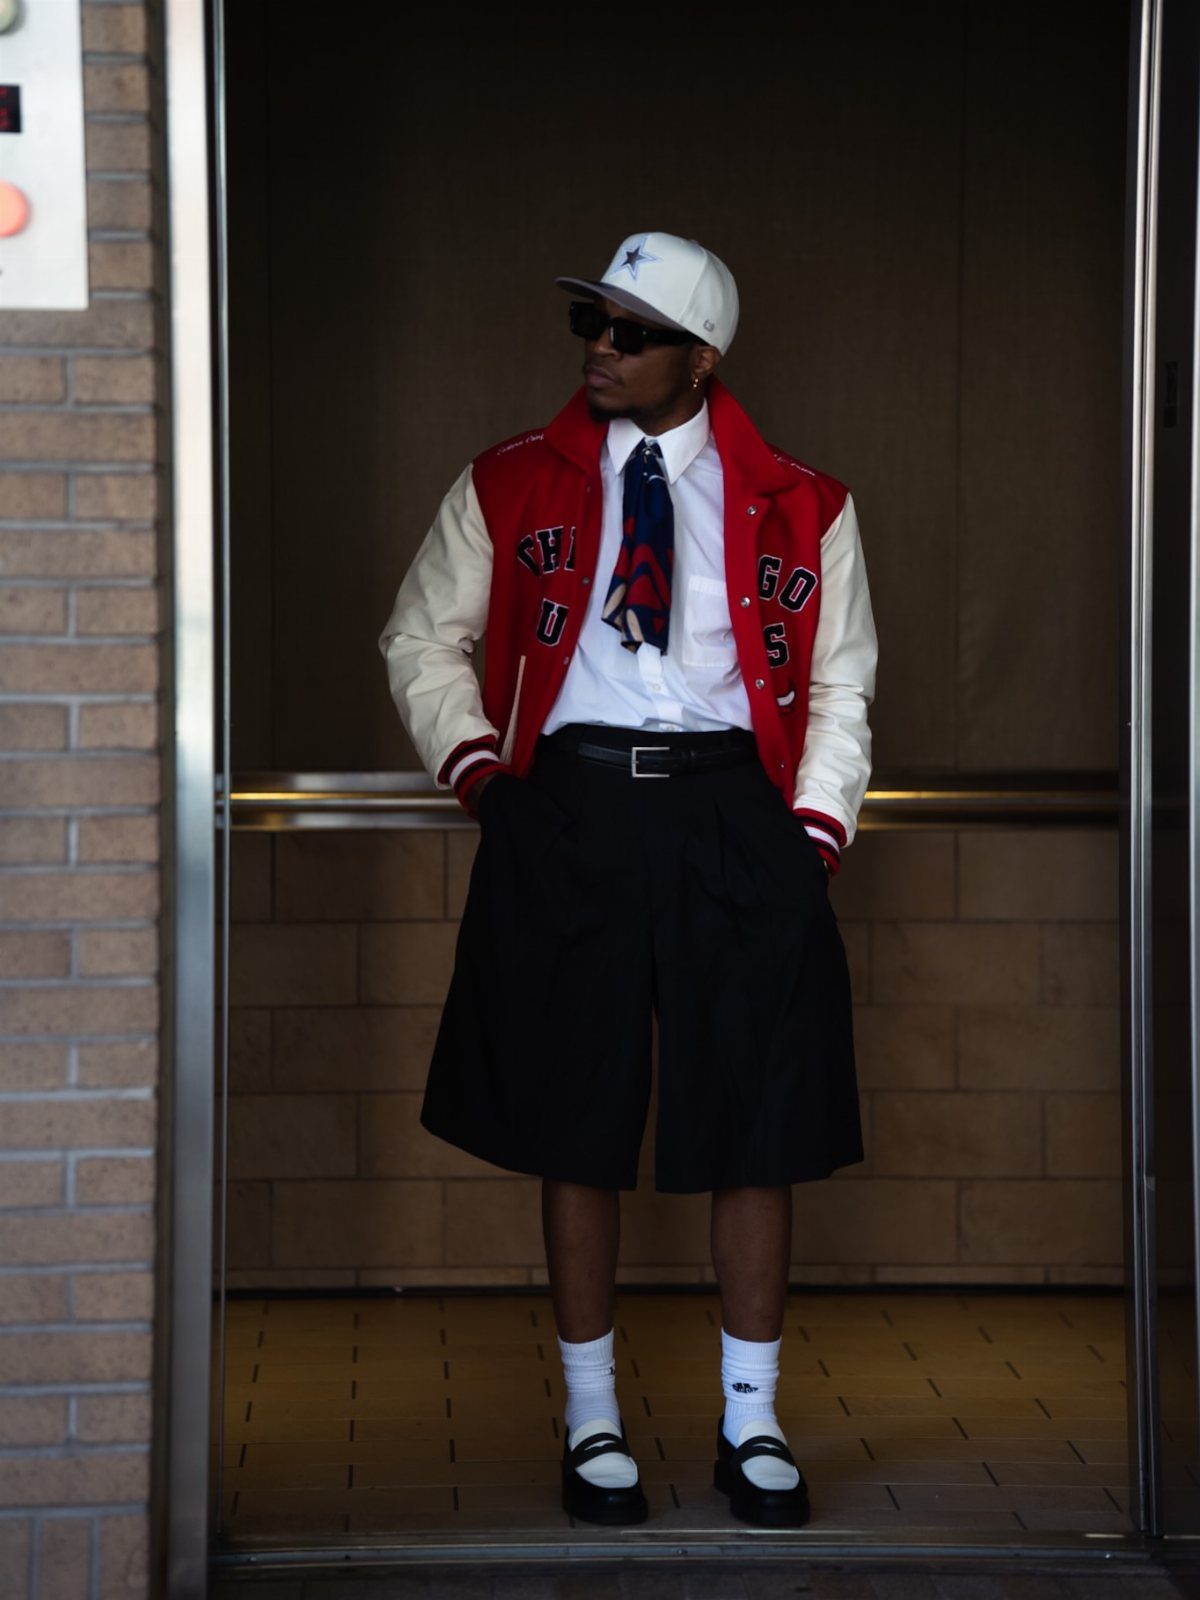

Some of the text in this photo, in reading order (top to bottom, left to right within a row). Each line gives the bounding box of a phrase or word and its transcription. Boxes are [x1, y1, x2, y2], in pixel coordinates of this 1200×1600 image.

[758, 554, 818, 612] GO
[537, 597, 790, 669] U S
